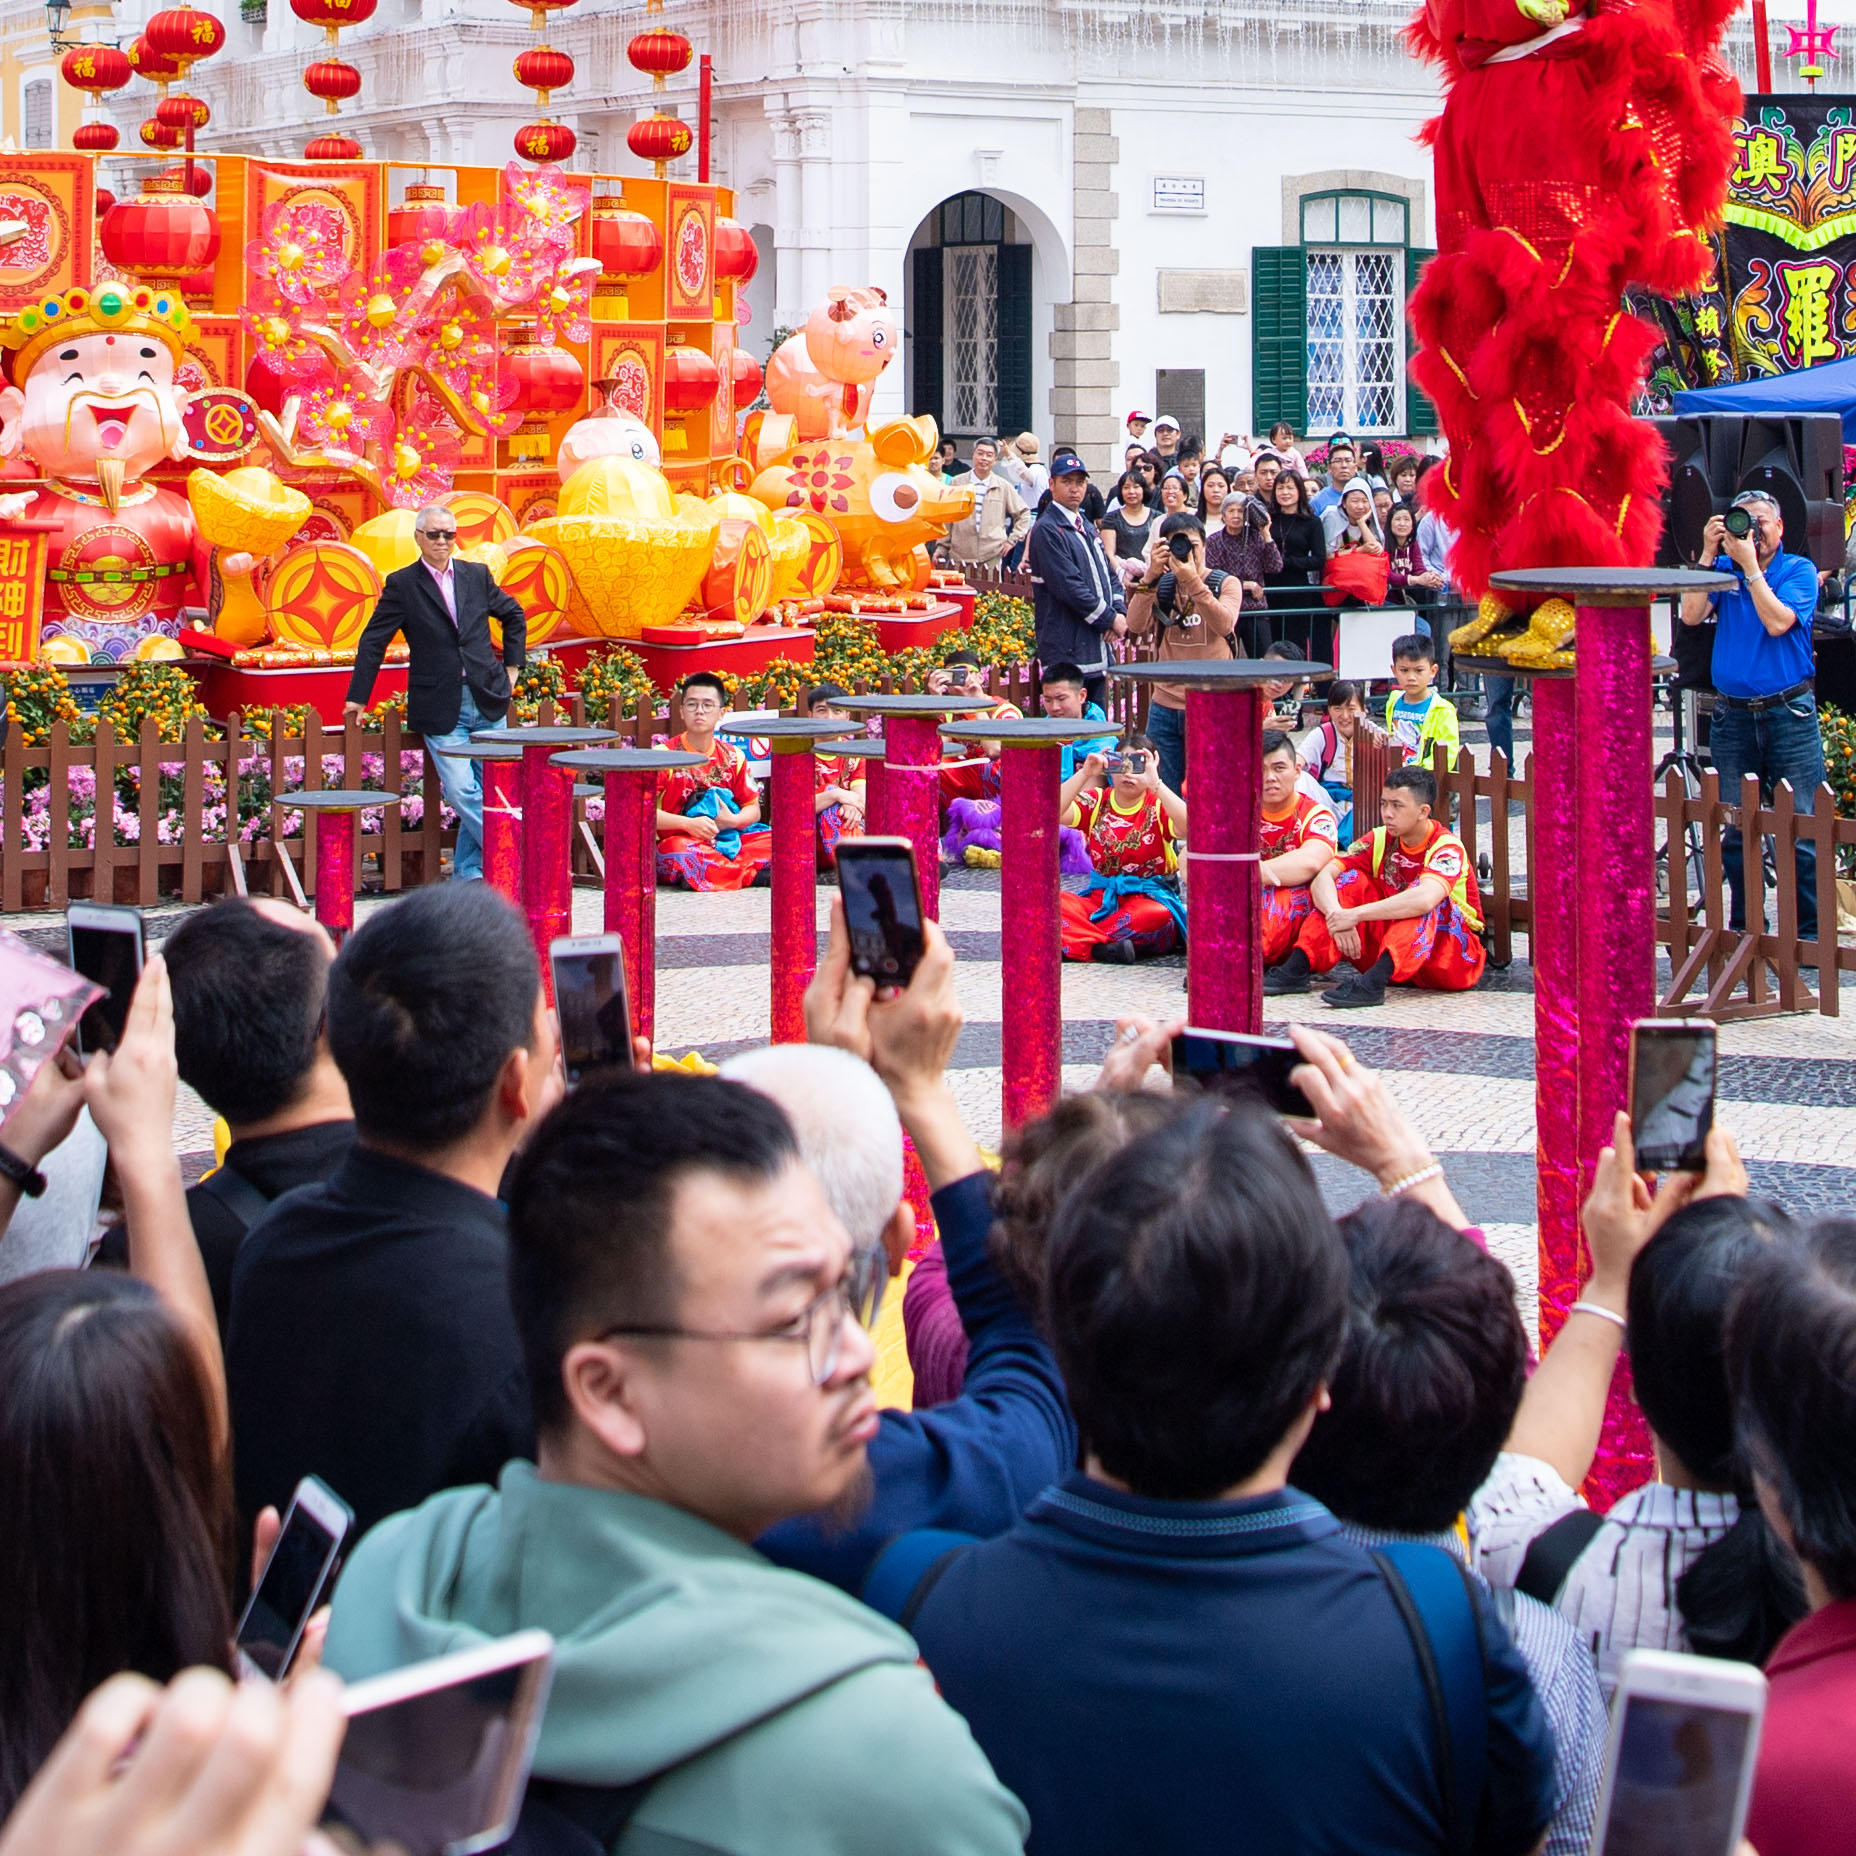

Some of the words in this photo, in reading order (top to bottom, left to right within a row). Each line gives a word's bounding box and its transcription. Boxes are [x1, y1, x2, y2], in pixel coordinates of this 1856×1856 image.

[191, 20, 216, 45] 福
[73, 56, 96, 79] 福
[193, 105, 209, 125] 福
[526, 133, 549, 156] 福
[671, 128, 690, 152] 福
[1783, 264, 1836, 368] 羅
